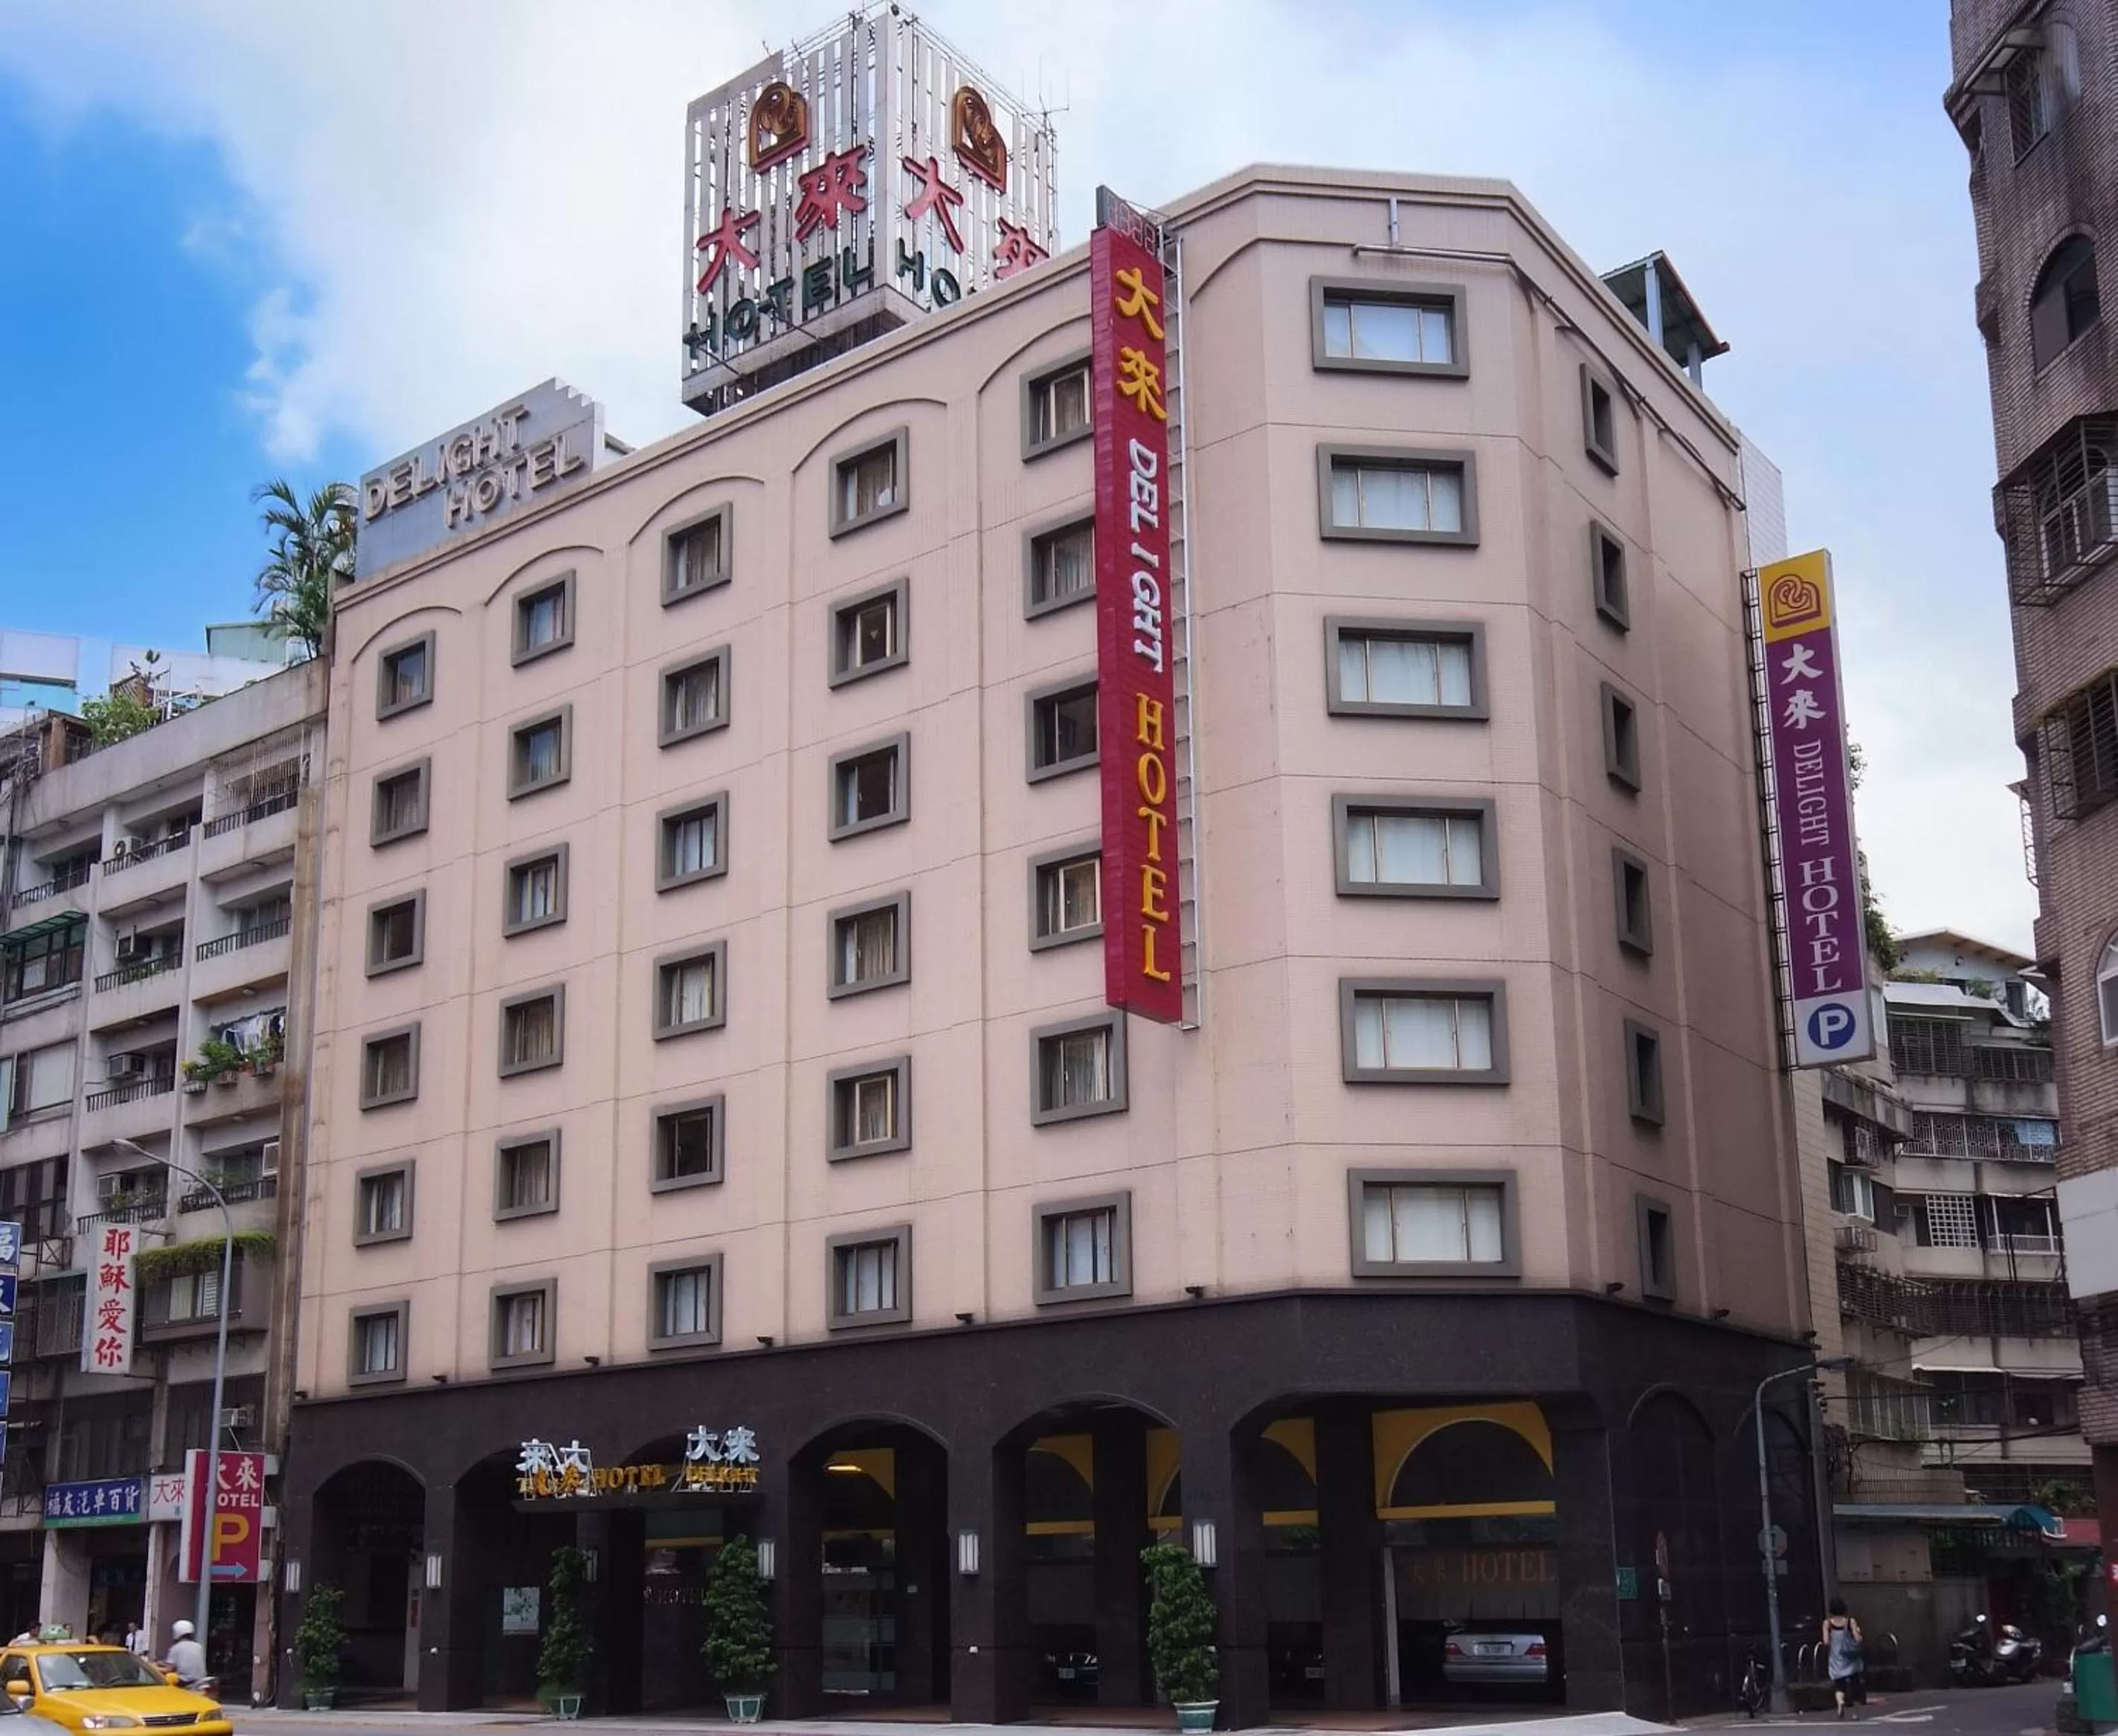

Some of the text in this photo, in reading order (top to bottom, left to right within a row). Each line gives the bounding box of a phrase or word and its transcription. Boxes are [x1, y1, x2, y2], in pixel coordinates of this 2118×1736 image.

[683, 246, 872, 359] HOTEL
[895, 238, 975, 307] HO
[365, 404, 530, 520] DELIGHT
[445, 435, 585, 529] HOTEL
[1129, 438, 1164, 674] DELIGHT
[1136, 692, 1171, 983] HOTEL
[1793, 738, 1829, 847] DELIGHT
[1798, 856, 1842, 993] HOTEL
[1818, 1009, 1849, 1046] P
[207, 1493, 260, 1508] OTEL
[593, 1463, 666, 1490] HOTEL
[212, 1512, 249, 1561] P
[1461, 1551, 1558, 1584] HOTEL
